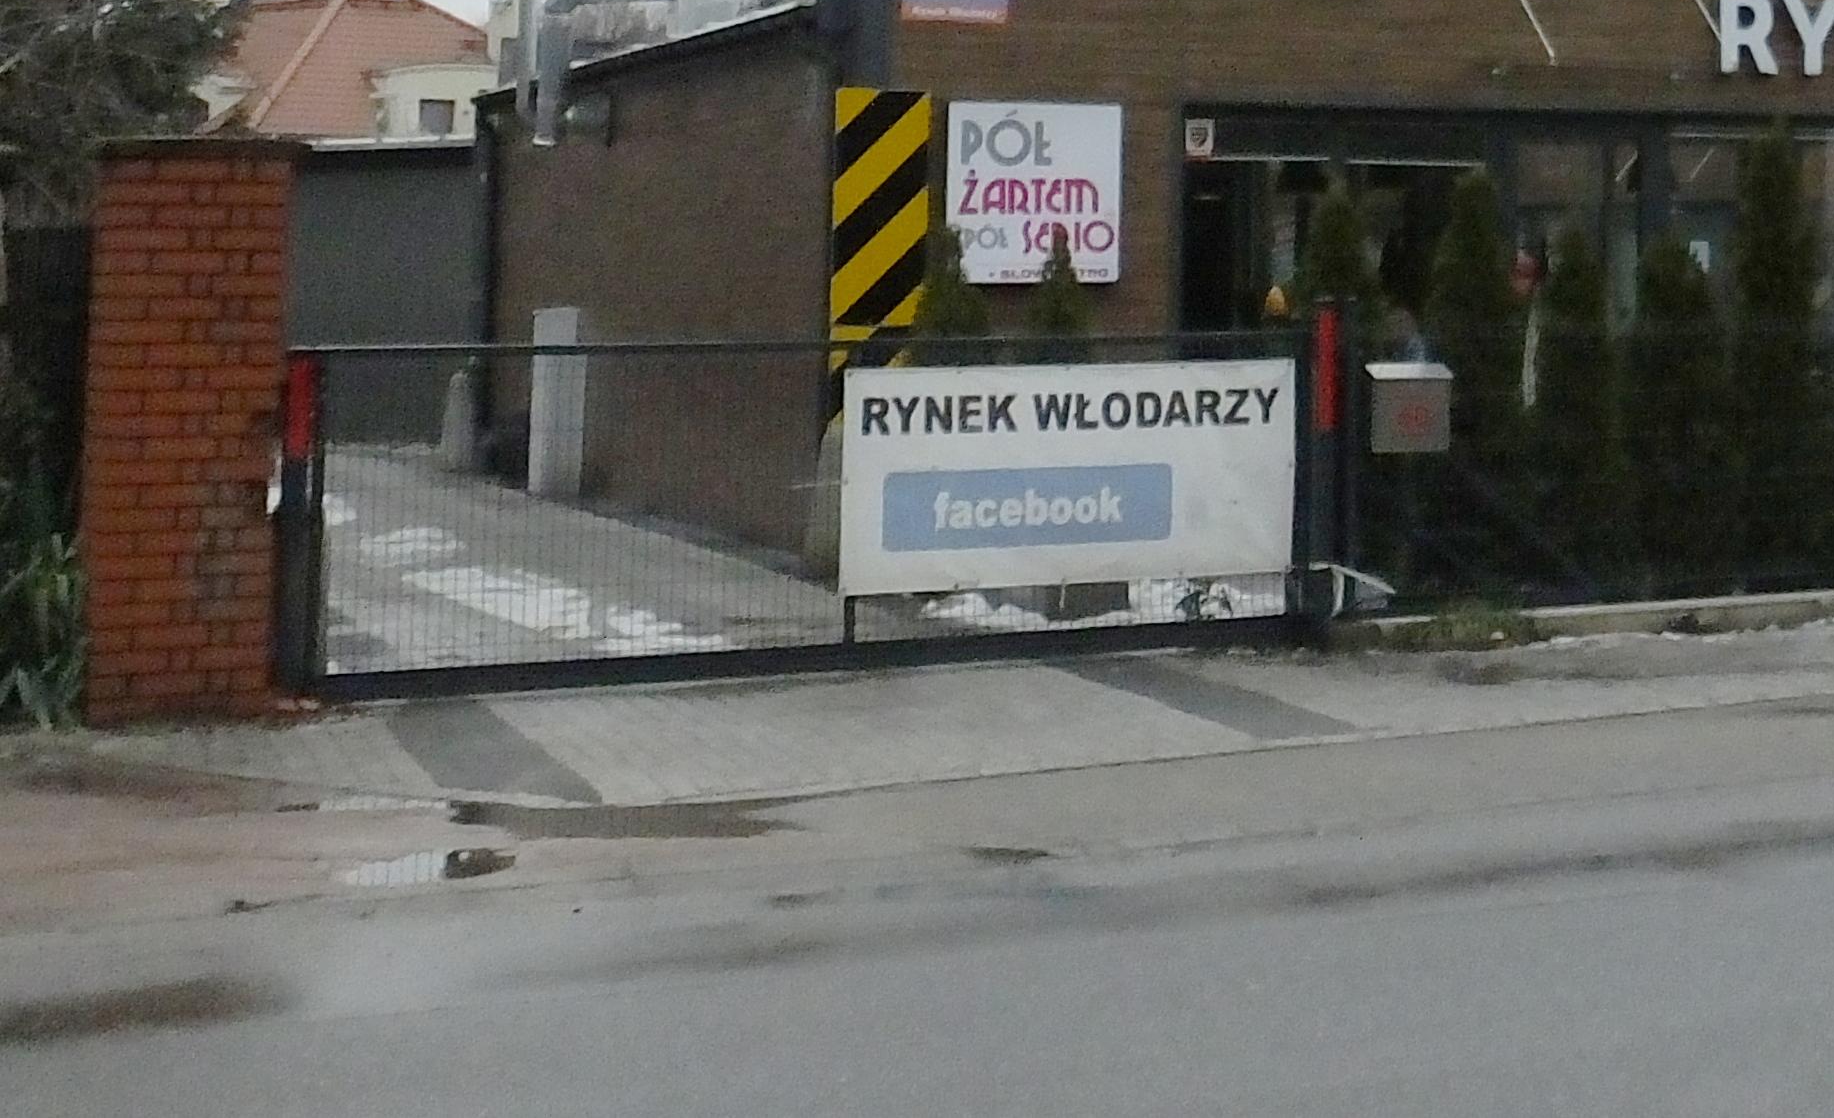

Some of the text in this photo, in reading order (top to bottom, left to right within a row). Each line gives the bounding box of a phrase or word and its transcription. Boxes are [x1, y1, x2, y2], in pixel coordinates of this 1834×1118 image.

[961, 109, 1053, 167] PÓŁ
[957, 169, 1100, 215] ŻARTEM
[963, 224, 1009, 250] PÓŁ
[860, 386, 1280, 436] RYNEK WŁODARZY
[933, 485, 1124, 533] facebook
